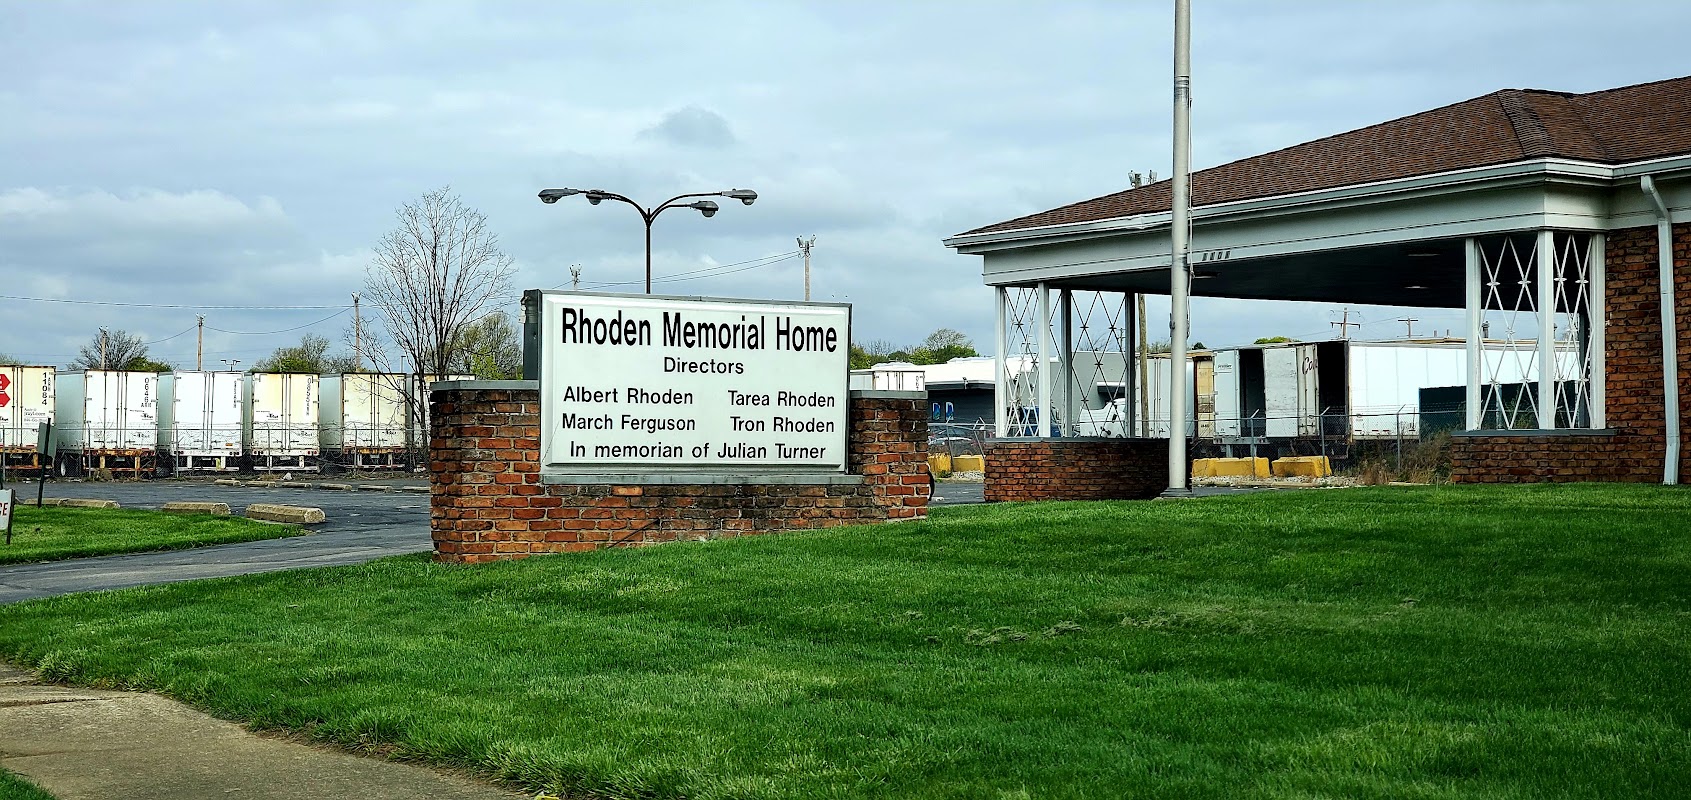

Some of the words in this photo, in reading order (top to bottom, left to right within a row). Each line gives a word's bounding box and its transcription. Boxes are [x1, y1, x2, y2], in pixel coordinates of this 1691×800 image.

[562, 307, 651, 347] Rhoden
[662, 311, 765, 350] Memorial
[776, 316, 837, 353] Home
[664, 356, 744, 375] Directors
[563, 385, 619, 403] Albert
[627, 387, 693, 405] Rhoden
[727, 389, 770, 407] Tarea
[777, 390, 835, 408] Rhoden
[562, 412, 613, 430] March
[621, 414, 696, 434] Ferguson
[729, 416, 765, 432] Tron
[773, 416, 835, 433] Rhoden
[570, 440, 586, 458] In
[594, 441, 683, 458] memorian
[691, 442, 710, 459] of
[717, 442, 767, 459] Julian
[774, 442, 827, 459] Turner
